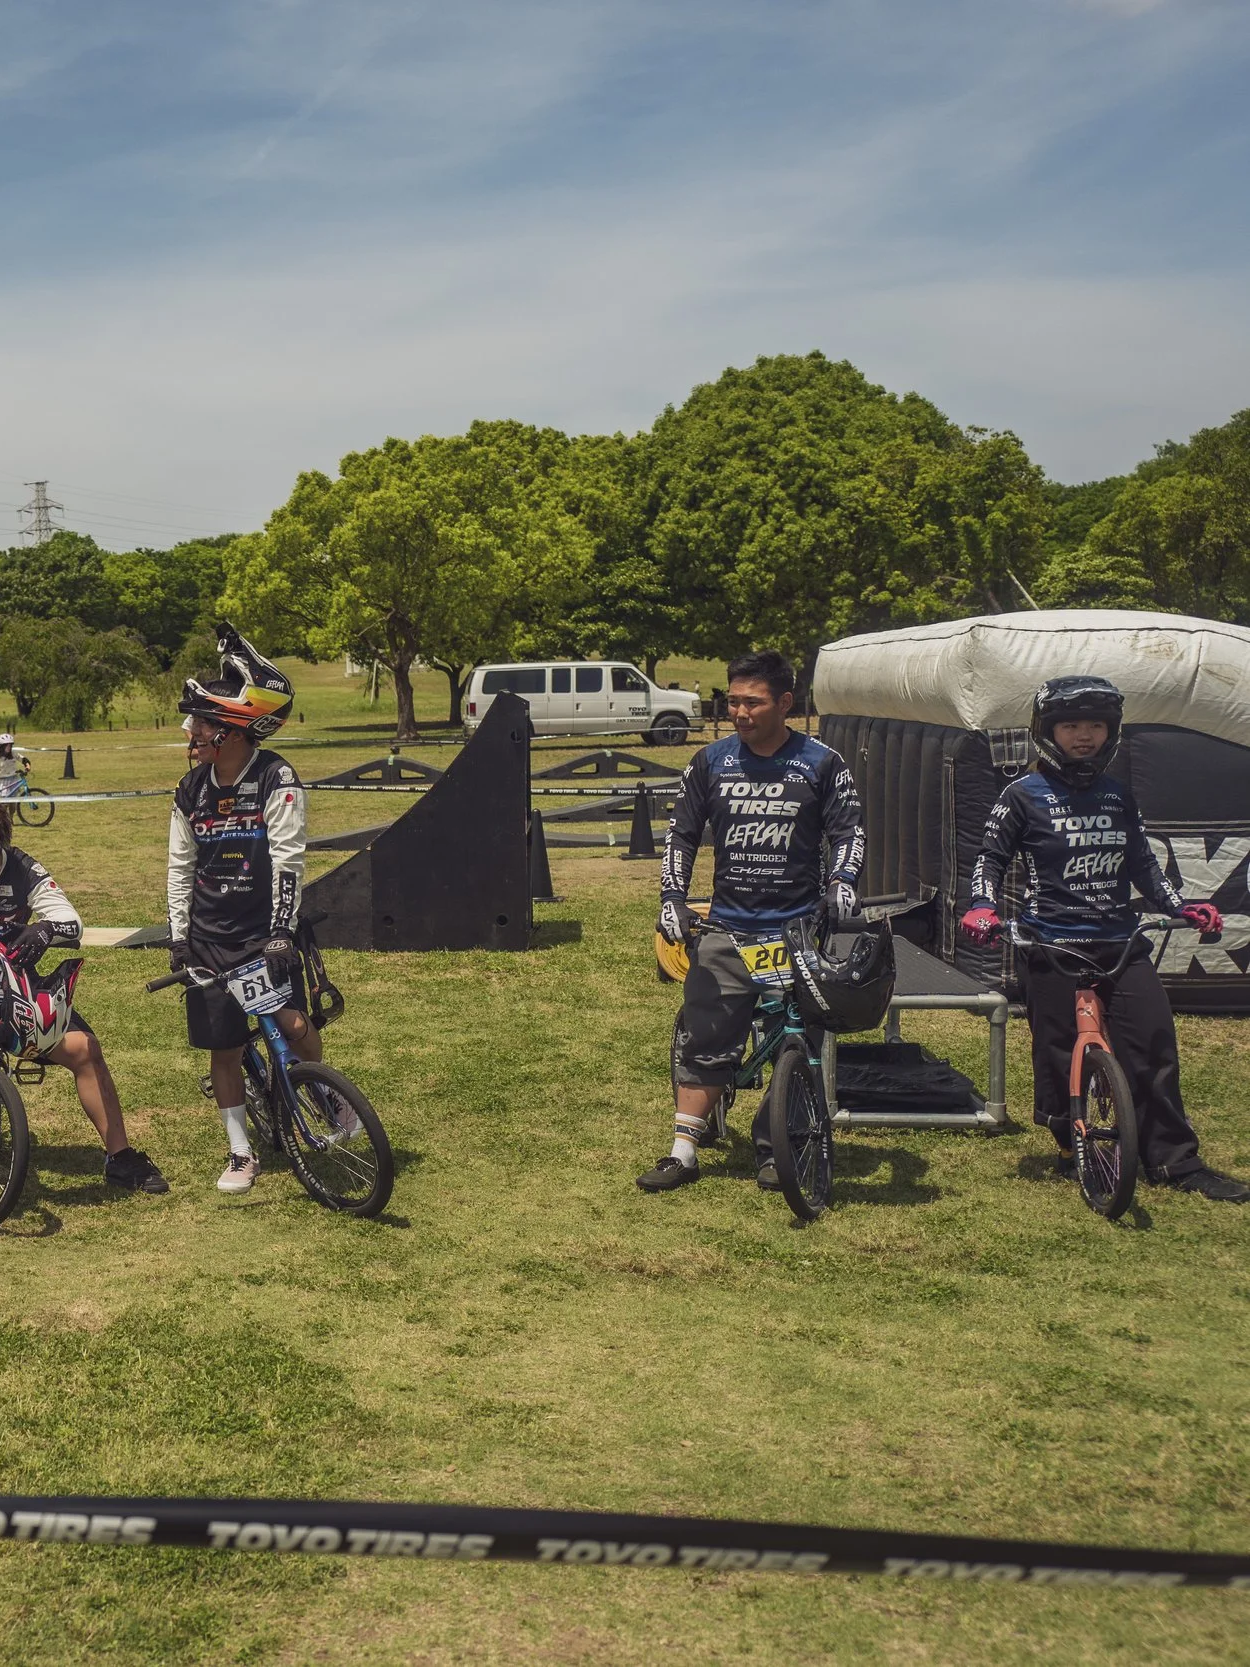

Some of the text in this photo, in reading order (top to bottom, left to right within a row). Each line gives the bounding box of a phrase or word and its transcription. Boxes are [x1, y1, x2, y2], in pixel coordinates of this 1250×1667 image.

[719, 782, 785, 797] TOYO
[728, 799, 802, 817] TIRES
[1051, 815, 1112, 832] TOYO
[1066, 831, 1127, 847] TIRES
[730, 852, 788, 862] GAN TRIGGER
[730, 866, 786, 875] CHASE
[755, 947, 788, 970] 20
[241, 975, 271, 1002] 51
[793, 950, 830, 1011] TOYO TIRES
[10, 1511, 156, 1546] TIRES
[207, 1521, 494, 1560] TOYO TIRES
[536, 1538, 830, 1574] TOYO TIRES
[883, 1557, 1025, 1582] TOYO
